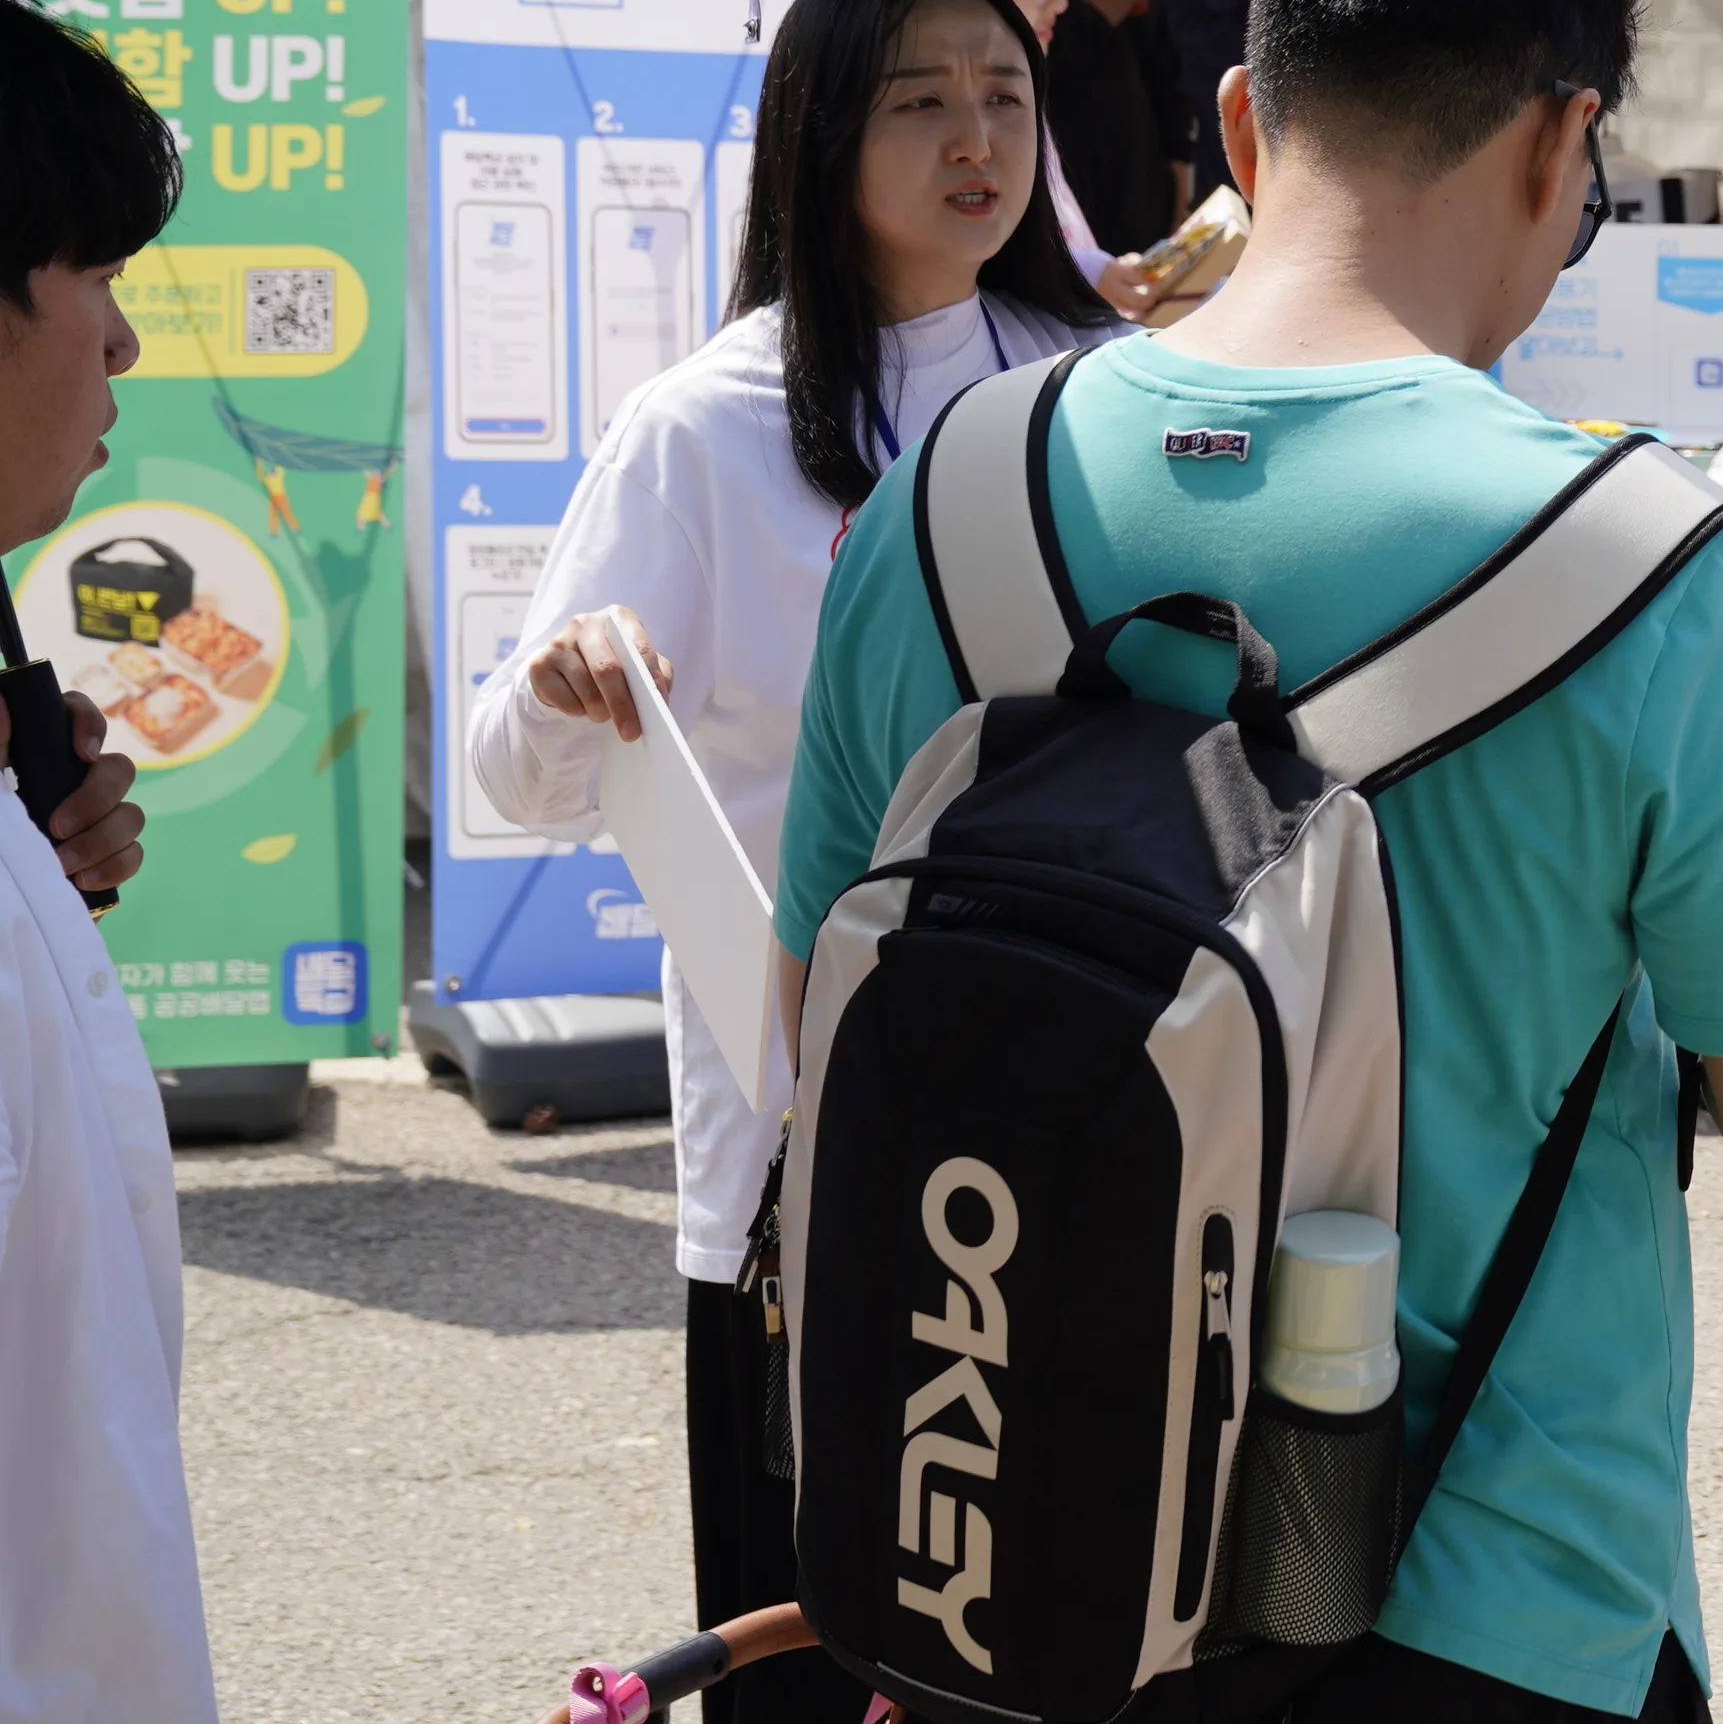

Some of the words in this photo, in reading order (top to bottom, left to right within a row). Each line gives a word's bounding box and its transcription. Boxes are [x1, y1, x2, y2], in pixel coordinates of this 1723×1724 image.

[213, 34, 346, 104] UP!
[592, 100, 625, 134] 2.
[212, 123, 345, 192] UP!
[897, 1155, 1020, 1676] OAKLEY
